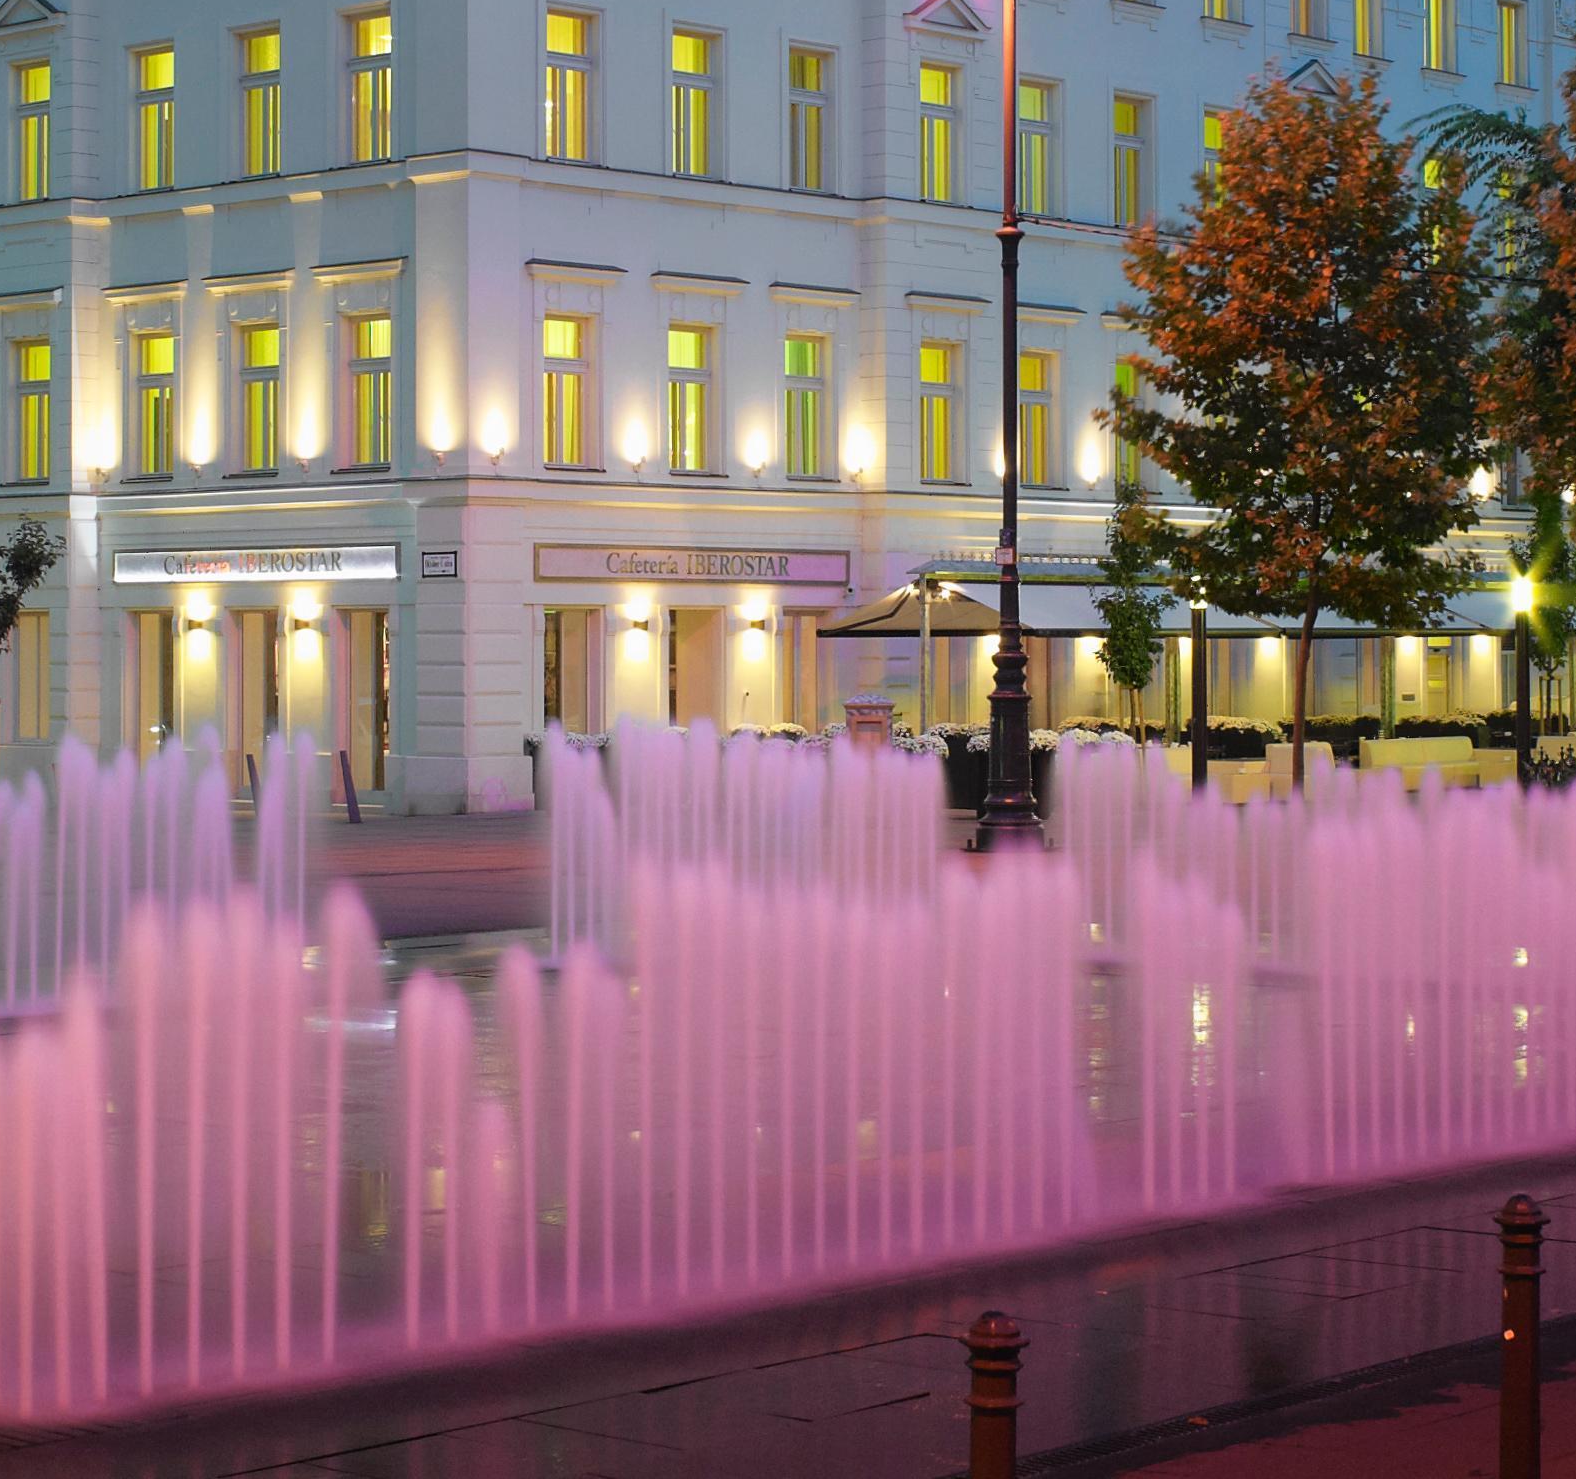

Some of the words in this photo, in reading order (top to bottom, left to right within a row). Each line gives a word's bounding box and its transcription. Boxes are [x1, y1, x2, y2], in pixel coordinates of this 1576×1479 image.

[238, 551, 343, 573] IBEROSTAR
[605, 551, 679, 575] Cafetería
[686, 553, 791, 576] IBEROSTAR
